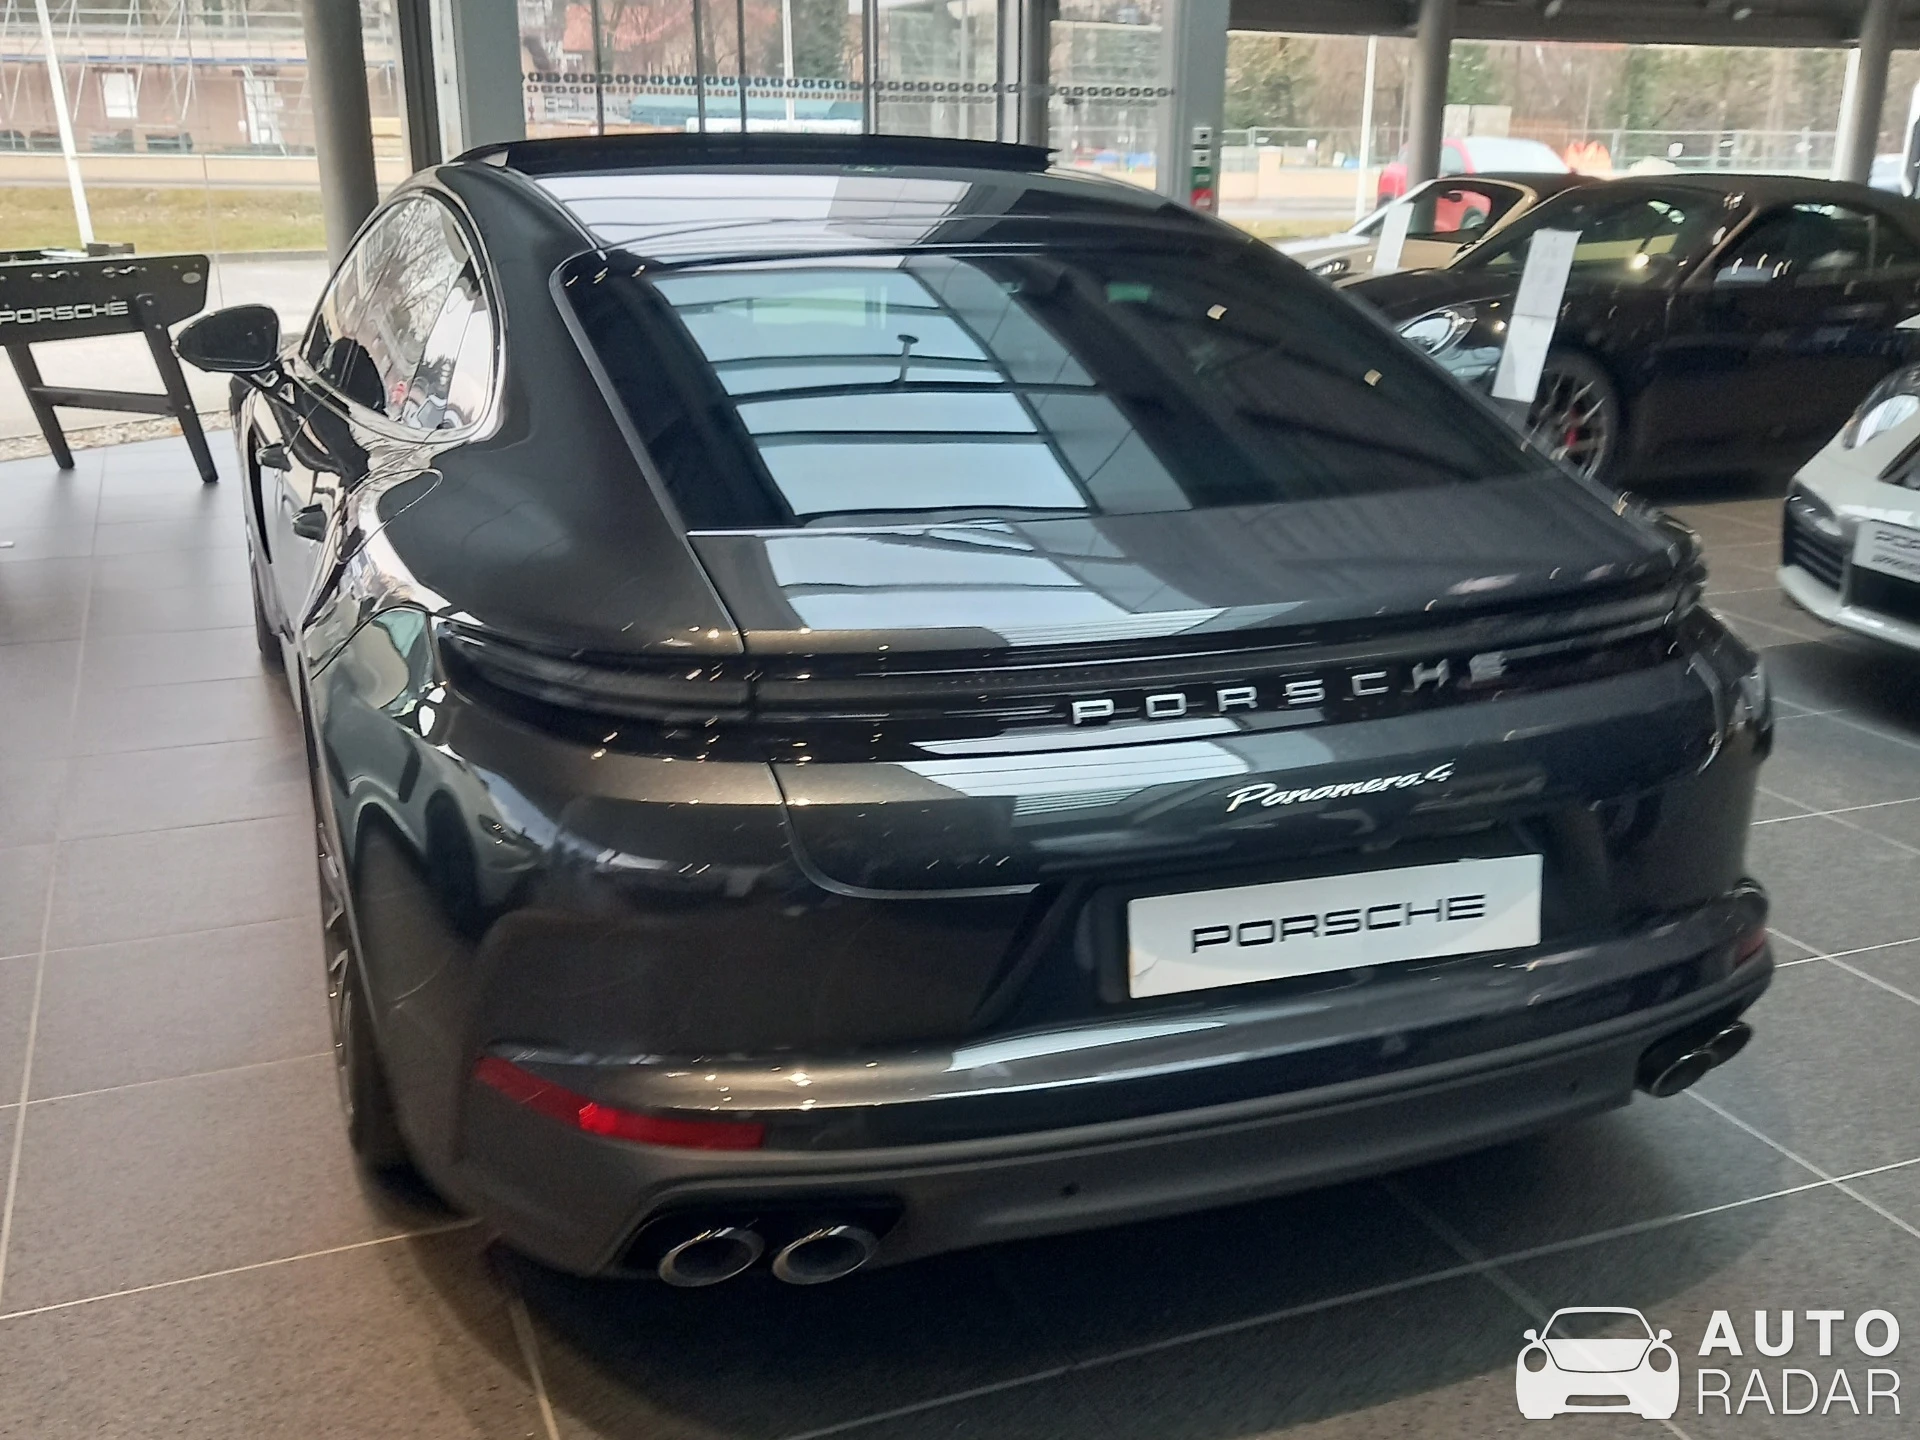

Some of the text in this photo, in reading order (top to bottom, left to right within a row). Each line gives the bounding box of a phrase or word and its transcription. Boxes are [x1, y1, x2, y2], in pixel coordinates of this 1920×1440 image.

[0, 301, 128, 324] PORSCHE
[1072, 651, 1508, 726] PORSCHE
[1191, 893, 1486, 954] PORSCHE
